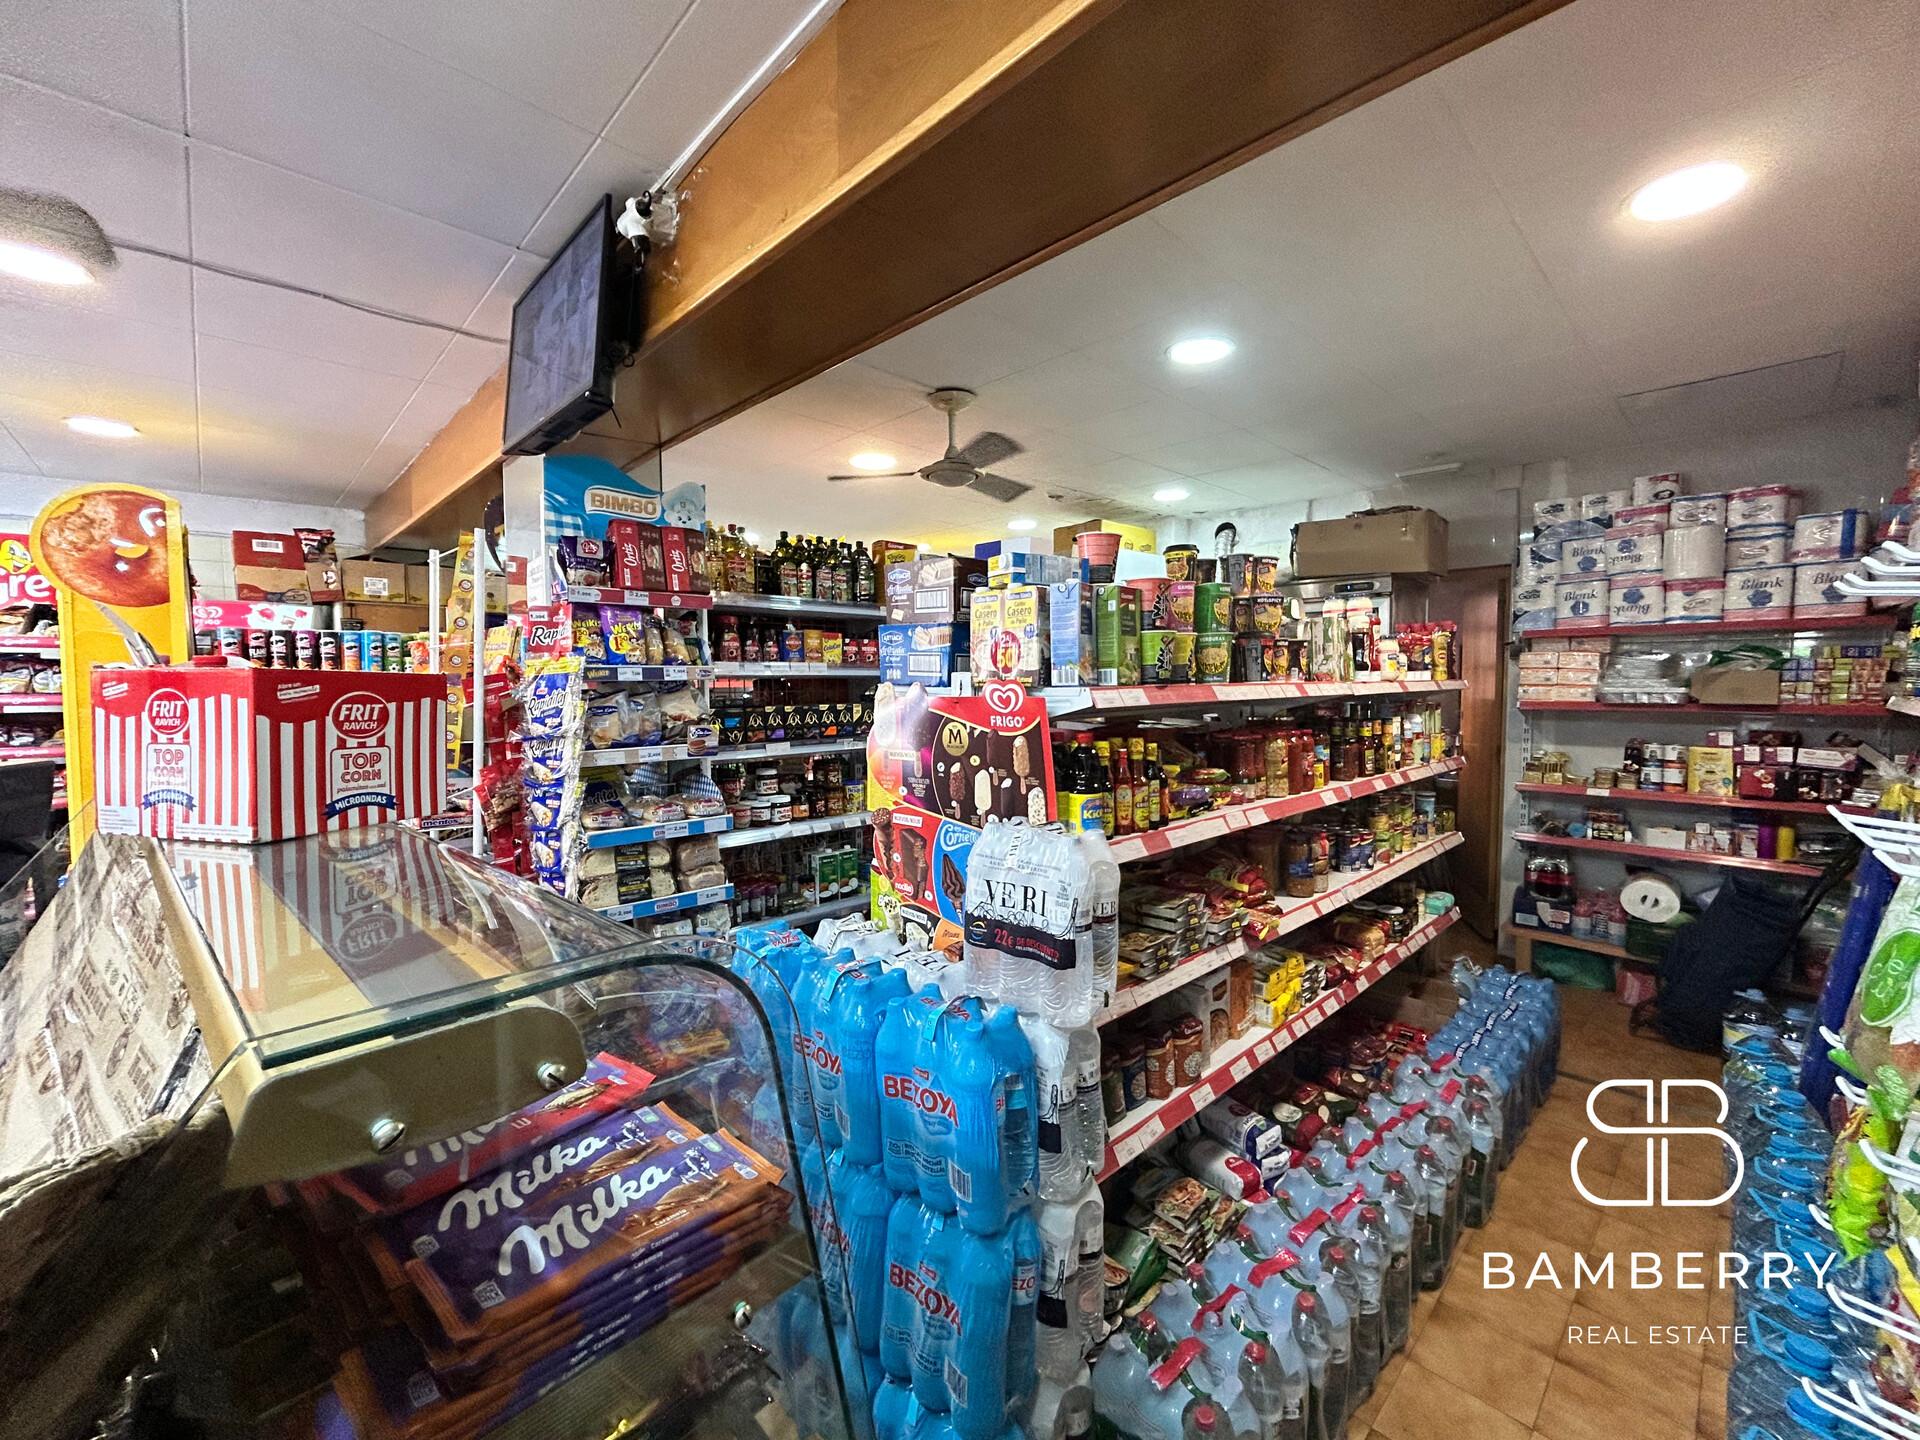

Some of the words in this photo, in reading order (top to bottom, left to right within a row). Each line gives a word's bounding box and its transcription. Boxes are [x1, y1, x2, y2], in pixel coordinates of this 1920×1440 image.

[590, 493, 657, 516] BIMBO
[622, 542, 640, 567] Ortiz
[670, 550, 686, 573] Ortiz
[1740, 577, 1785, 590] Blank
[1564, 590, 1598, 601] Blank
[975, 609, 997, 619] Casero
[1007, 606, 1032, 617] Casero
[152, 700, 185, 717] FRIT
[339, 703, 384, 721] FRIT
[155, 717, 181, 727] RAVICH
[343, 720, 378, 731] RAVICH
[990, 715, 1024, 728] FRIGO
[948, 728, 964, 745] M
[154, 748, 184, 765] TOP
[341, 752, 382, 771] TOP
[341, 769, 382, 784] CORN
[334, 794, 388, 811] MICROONDAS
[422, 818, 459, 827] mentos
[983, 878, 1048, 918] VERI
[994, 927, 1014, 948] 22€
[883, 1074, 960, 1128] BEZOYA
[438, 1134, 611, 1233] Milka
[498, 1165, 675, 1276] Milka
[655, 1208, 688, 1227] Caramelo
[889, 1262, 963, 1337] BEZOYA
